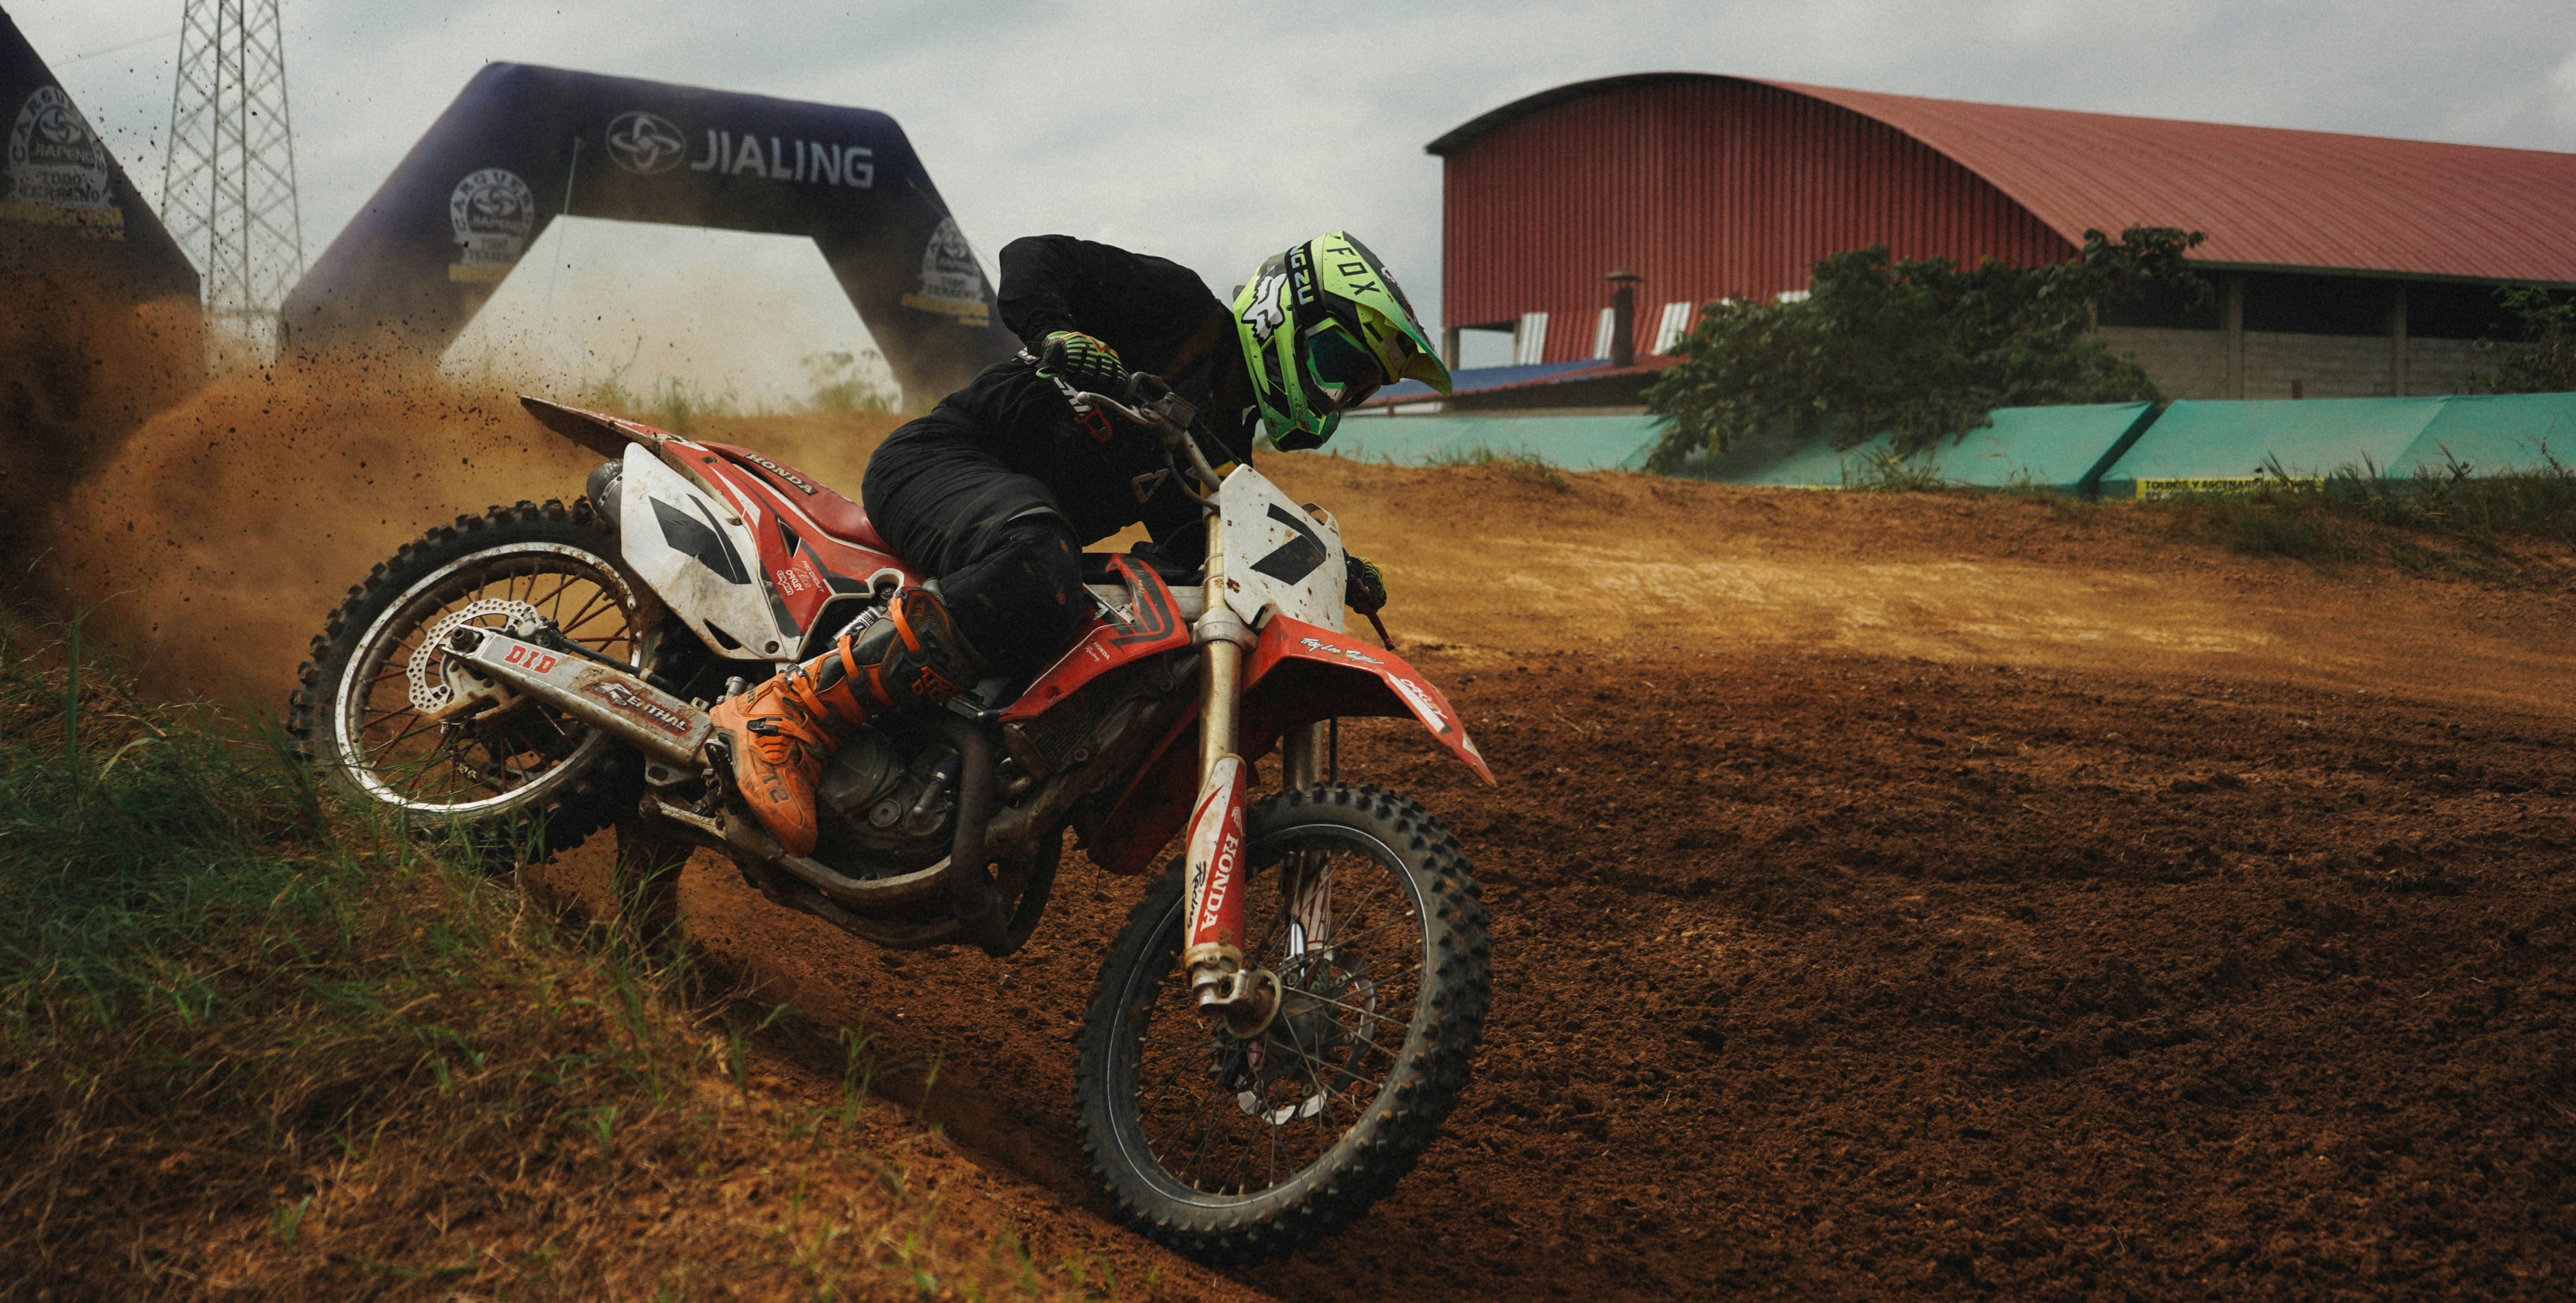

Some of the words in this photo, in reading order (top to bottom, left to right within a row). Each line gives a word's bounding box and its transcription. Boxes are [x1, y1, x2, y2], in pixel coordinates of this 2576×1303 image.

[691, 129, 874, 189] JIALING
[1326, 247, 1381, 296] FOX
[746, 454, 812, 493] HONDA
[1249, 502, 1327, 586] 7
[786, 569, 804, 591] OAKLEY
[801, 560, 811, 571] PRO
[809, 571, 824, 593] CIRCUIT
[1093, 642, 1110, 660] HONDA
[1299, 637, 1324, 652] Troy
[1320, 644, 1341, 654] Lee
[1400, 679, 1449, 719] OAKLEY
[1186, 860, 1206, 929] Racing
[1200, 832, 1239, 932] HONDA
